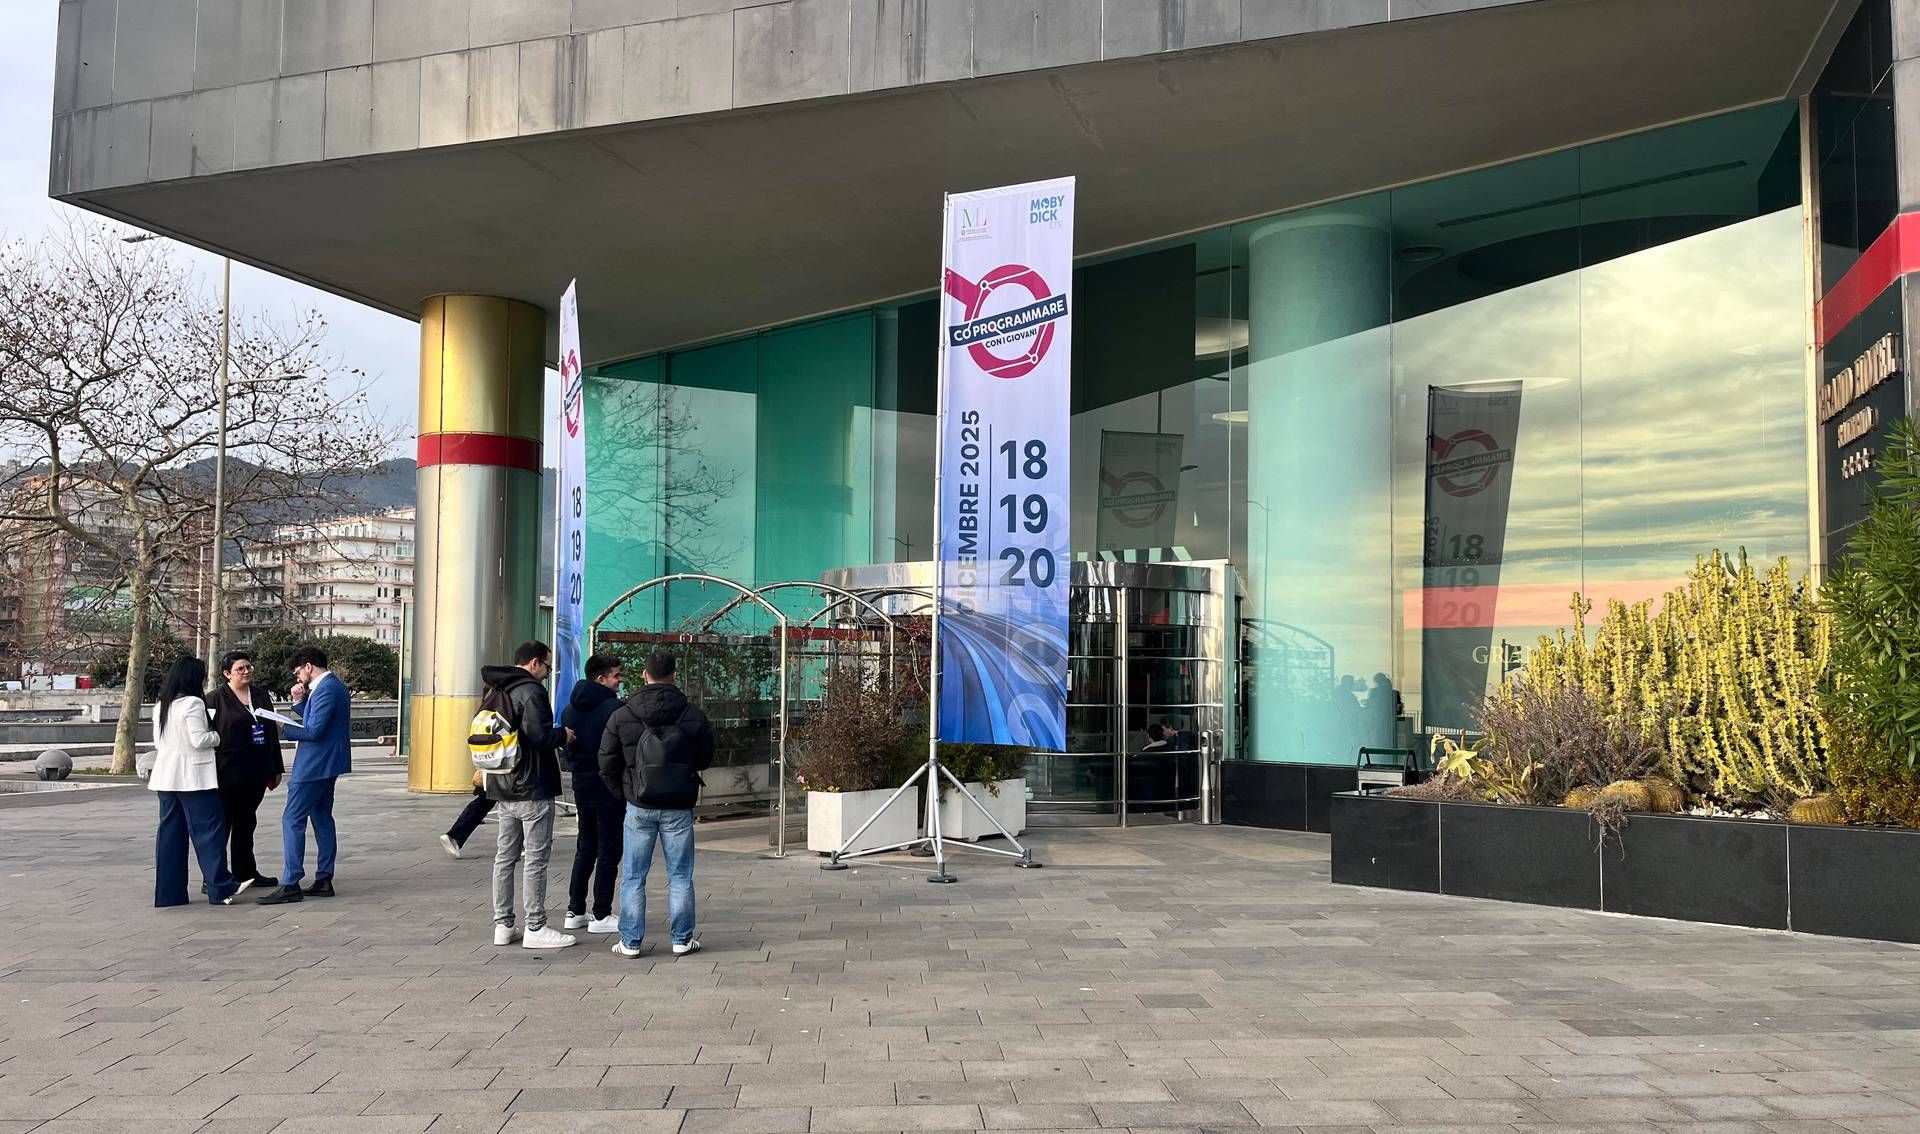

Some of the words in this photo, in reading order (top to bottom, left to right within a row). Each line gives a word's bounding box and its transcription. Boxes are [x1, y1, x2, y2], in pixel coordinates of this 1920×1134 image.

[1030, 195, 1065, 211] MOBY
[1030, 209, 1058, 224] DICK
[985, 336, 1002, 349] CON
[1006, 328, 1037, 343] GIOVANI
[960, 410, 980, 476] 2025
[999, 439, 1048, 480] 18
[572, 486, 582, 518] 18
[999, 493, 1048, 534] 19
[572, 529, 581, 561] 19
[1449, 534, 1484, 560] 18
[999, 546, 1056, 588] 20
[1445, 567, 1480, 593] 19
[570, 572, 582, 605] 20
[1440, 601, 1481, 626] 20
